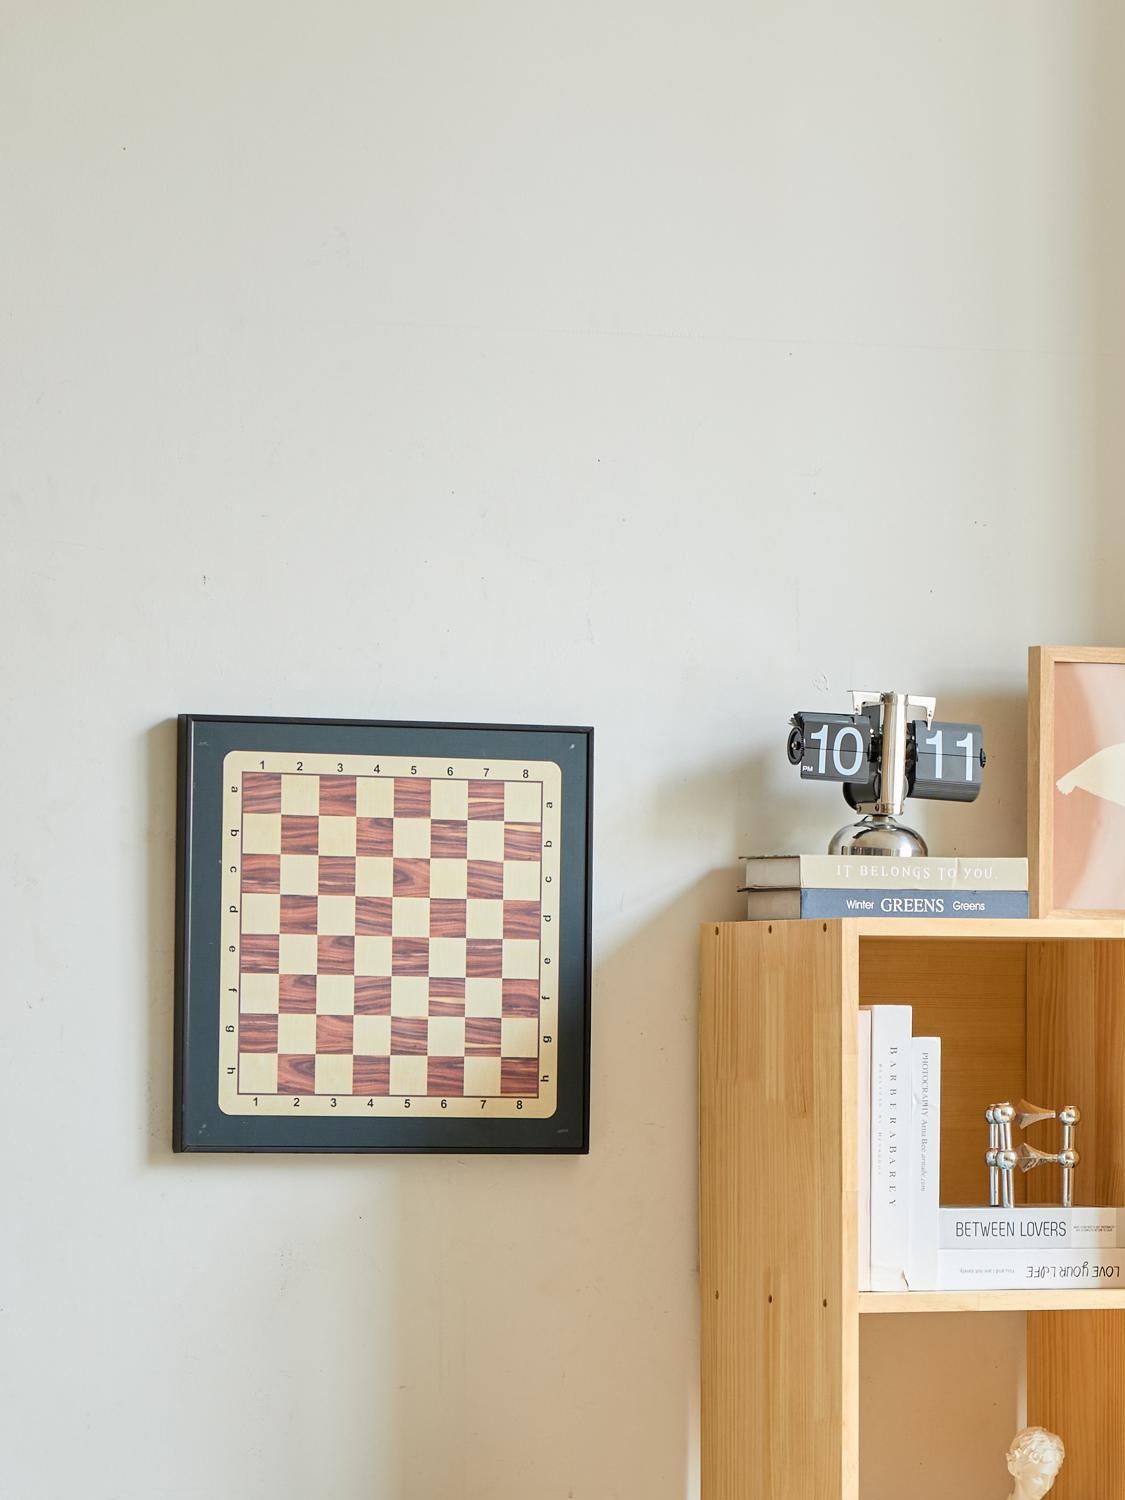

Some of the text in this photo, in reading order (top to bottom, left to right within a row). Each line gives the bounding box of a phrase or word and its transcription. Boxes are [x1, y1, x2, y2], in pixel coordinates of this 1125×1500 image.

[811, 725, 863, 776] 10
[926, 730, 973, 781] 11
[260, 760, 529, 778] 1 2 3 4 5 6 7 8
[837, 865, 855, 877] IT
[860, 865, 930, 879] BELONGS
[937, 867, 957, 880] TO
[846, 898, 985, 913] Winter GREENS Greens
[253, 1097, 522, 1109] 1 2 3 4 5 6 7 8
[956, 1221, 1014, 1237] BETWEEN
[1020, 1221, 1067, 1237] LOVERS
[1091, 1265, 1120, 1277] LOVE
